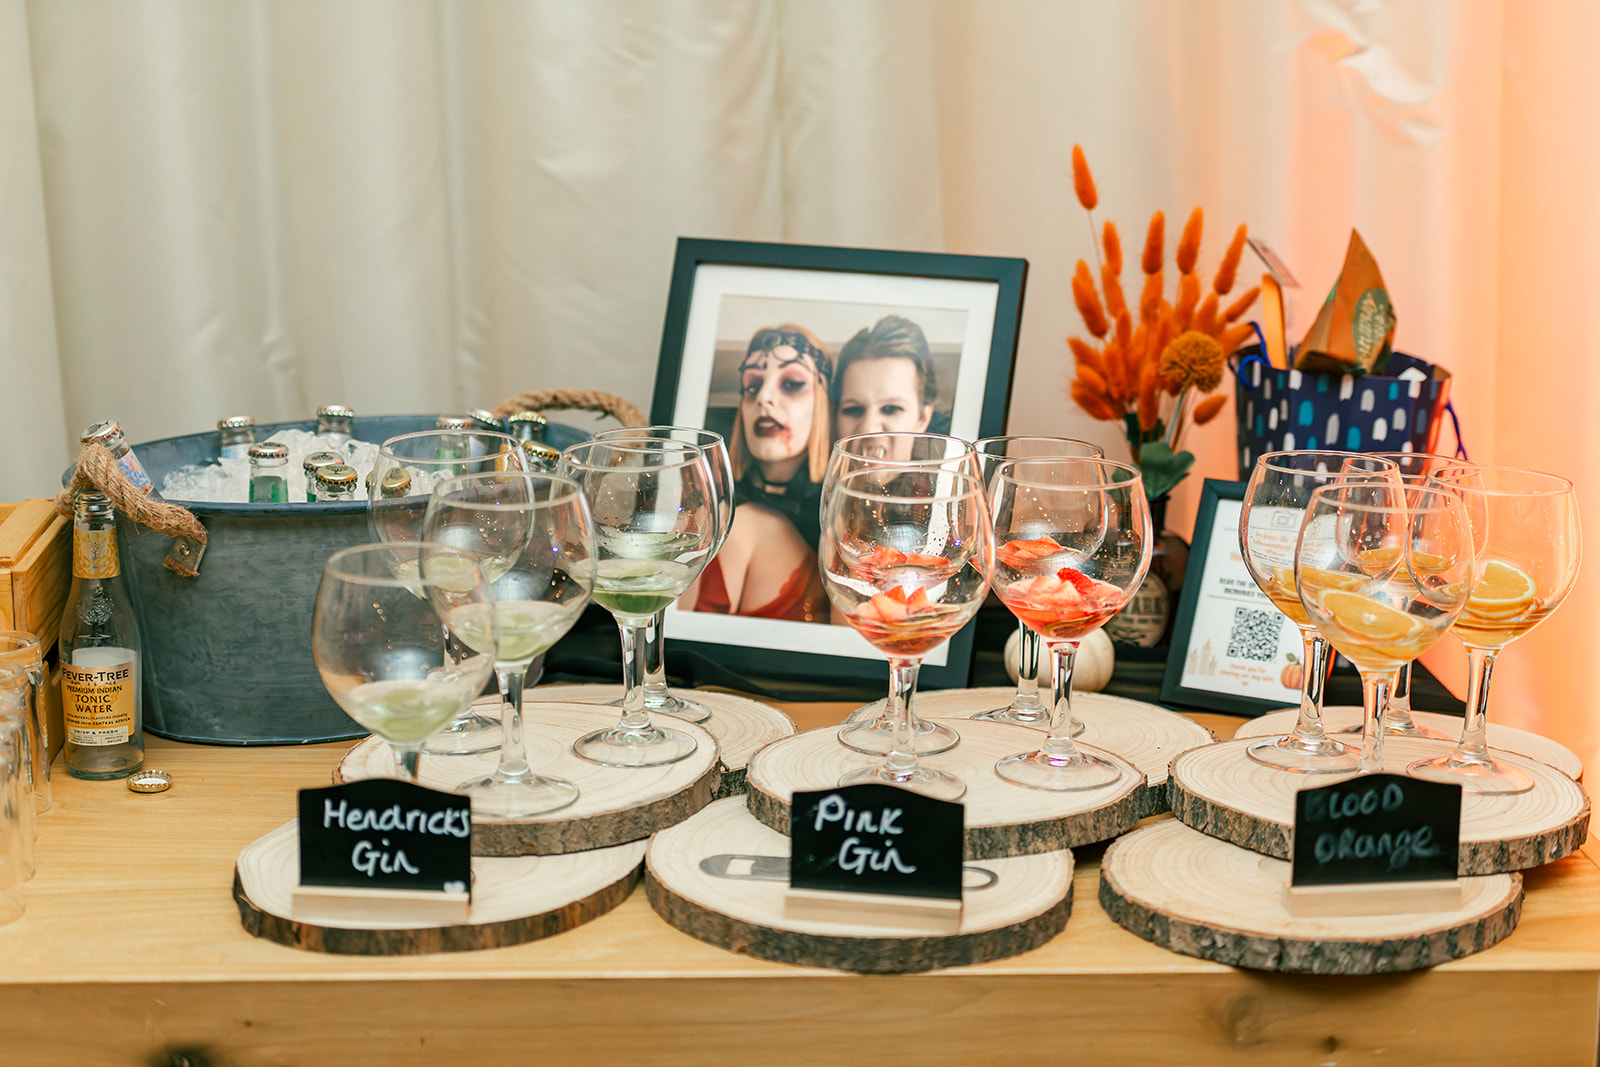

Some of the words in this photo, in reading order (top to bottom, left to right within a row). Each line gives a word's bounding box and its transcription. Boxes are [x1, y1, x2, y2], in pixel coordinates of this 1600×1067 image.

[62, 668, 129, 682] FEVER-TREE
[66, 684, 95, 694] PREMIUM
[96, 685, 123, 694] INDIAN
[75, 694, 111, 704] TONIC
[75, 704, 113, 713] WATER
[323, 798, 471, 838] Hendricks
[351, 838, 420, 877] Gin
[838, 836, 917, 875] Gin
